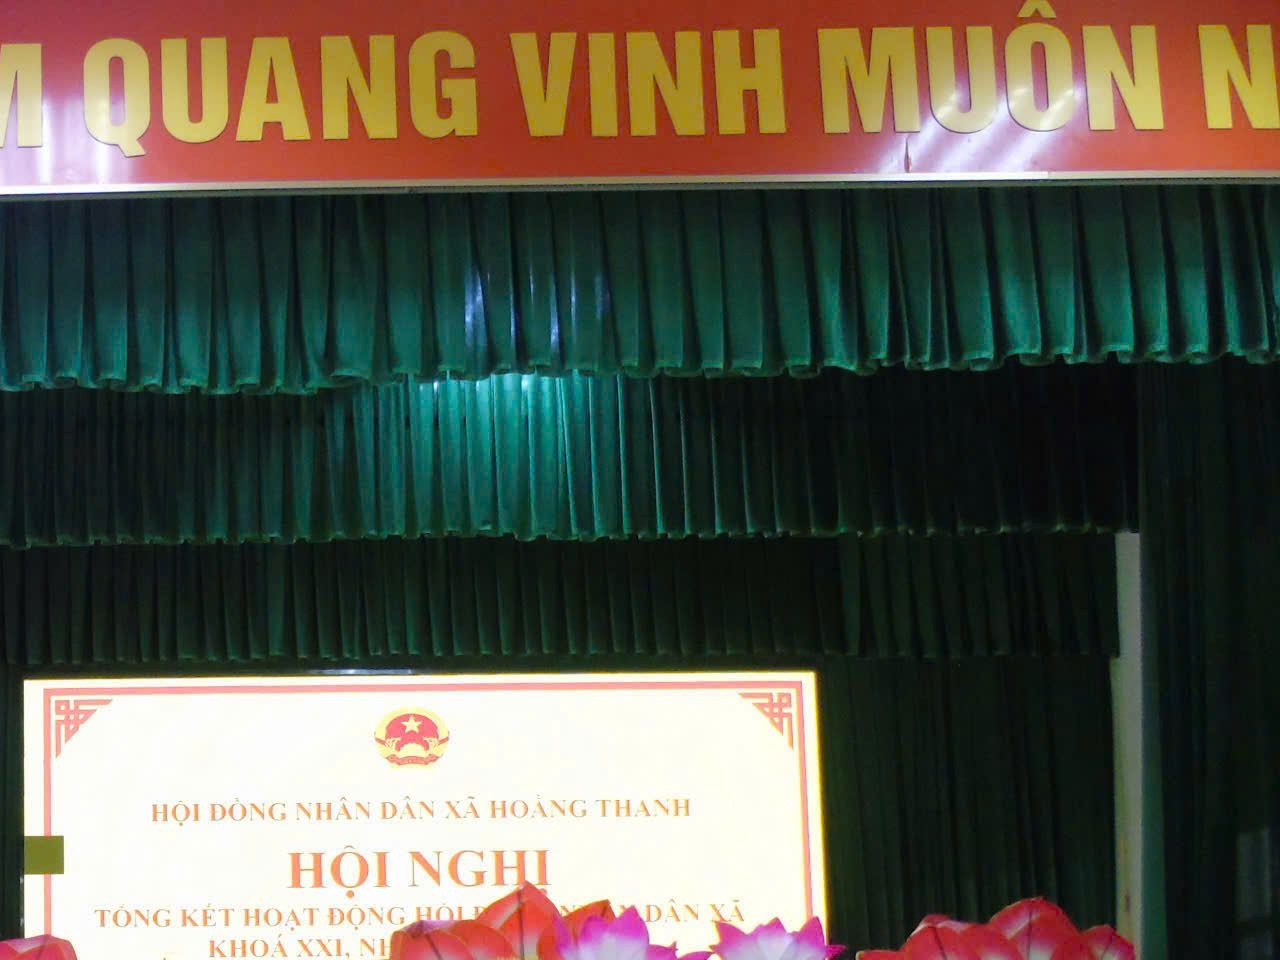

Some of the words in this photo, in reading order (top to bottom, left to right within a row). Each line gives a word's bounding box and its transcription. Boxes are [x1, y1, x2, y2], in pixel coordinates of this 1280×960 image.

[82, 30, 479, 158] QUANG
[511, 27, 787, 137] VINH
[817, 0, 1165, 134] MUÔN
[1198, 24, 1280, 130] N
[151, 800, 201, 827] HỘI
[295, 796, 372, 821] NHÂN
[380, 795, 435, 821] DÂN
[444, 796, 481, 820] XÃ
[595, 798, 691, 818] THANH
[286, 844, 392, 899] HỘI
[180, 902, 235, 928] KẾT
[242, 907, 320, 931] HOẠT
[326, 904, 406, 931] ĐỘNG
[645, 898, 700, 923] DÂN
[208, 933, 289, 958] KHOÁ
[296, 938, 351, 959] XXI,
